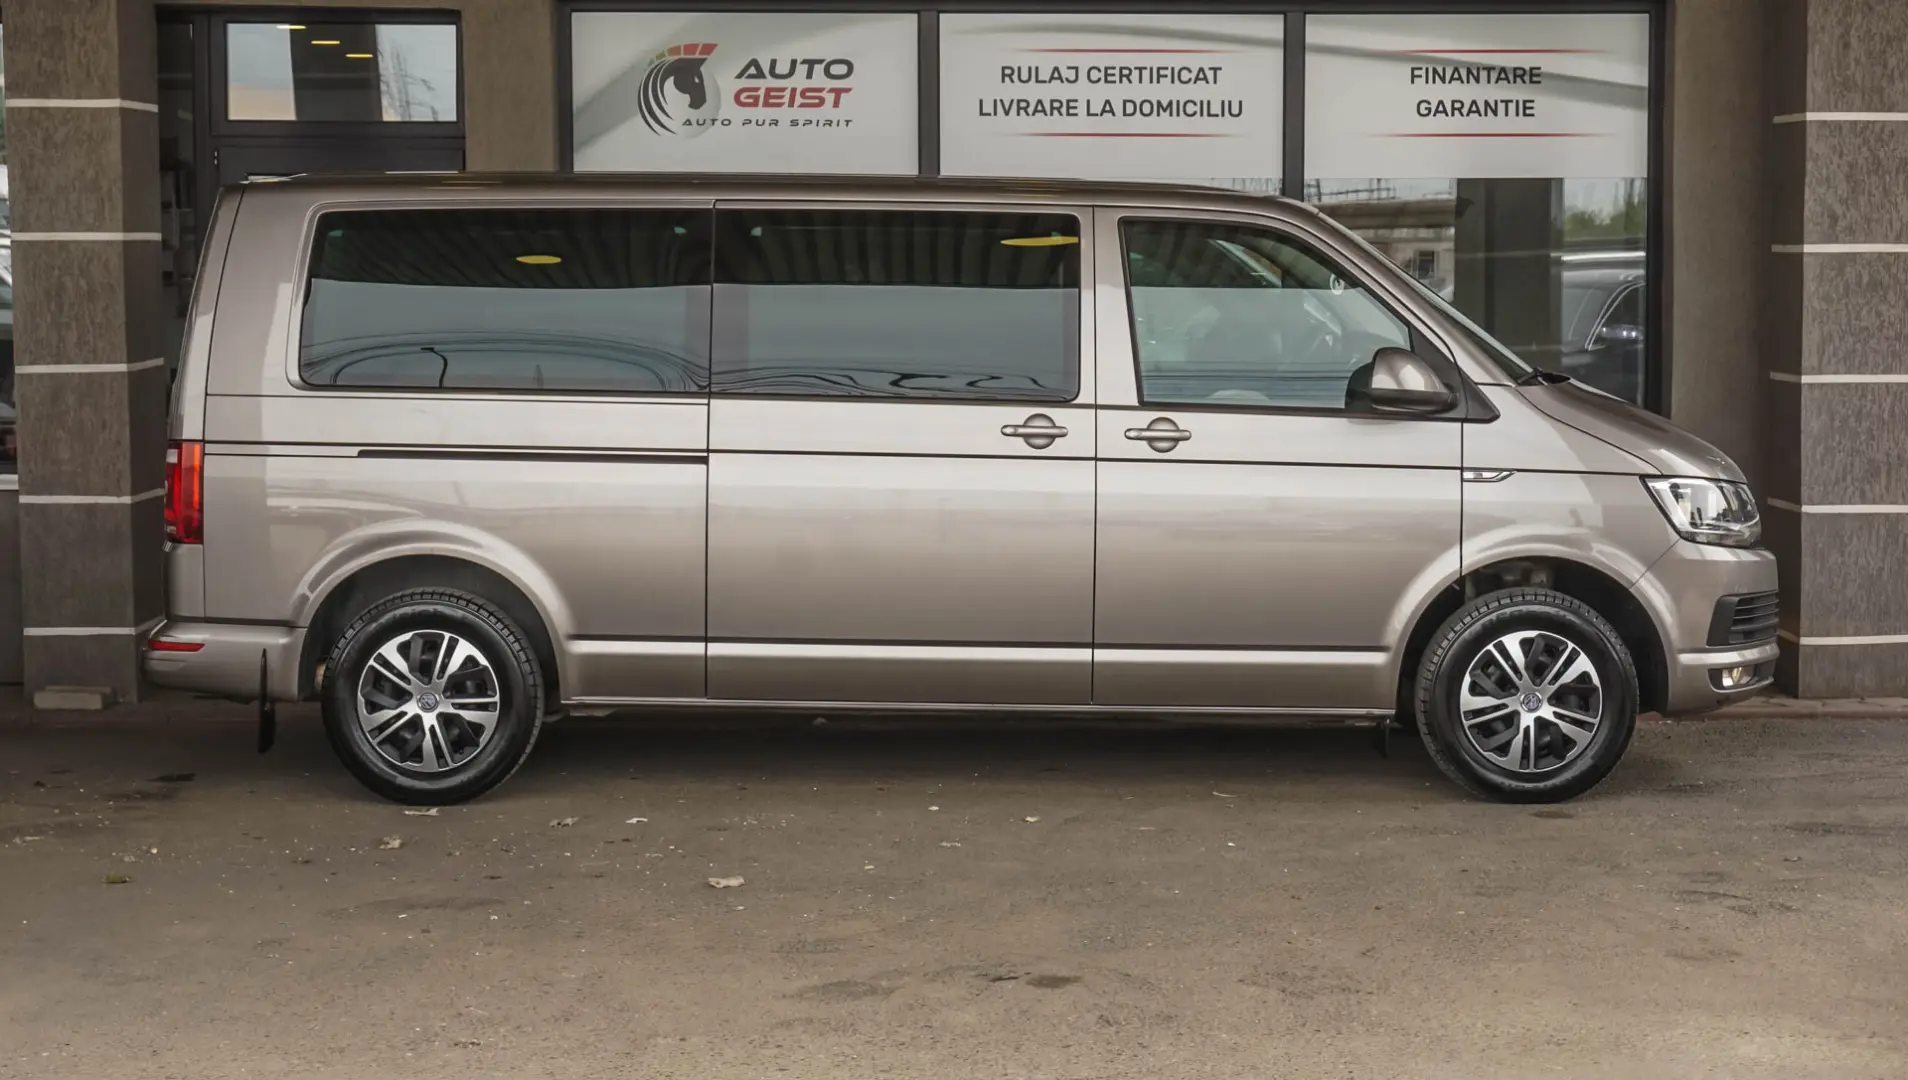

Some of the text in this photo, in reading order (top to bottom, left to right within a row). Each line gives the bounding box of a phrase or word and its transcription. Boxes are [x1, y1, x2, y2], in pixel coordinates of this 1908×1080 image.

[734, 57, 855, 81] AUTO
[1000, 65, 1223, 85] RULAJ CERTIFICAT
[1410, 65, 1543, 85] FINANTARE
[733, 86, 854, 109] GEIST
[978, 98, 1243, 118] LIVRARE LA DOMICILIU
[1416, 98, 1536, 118] GARANTIE
[681, 118, 854, 128] AUTO PUR SPIRIT
